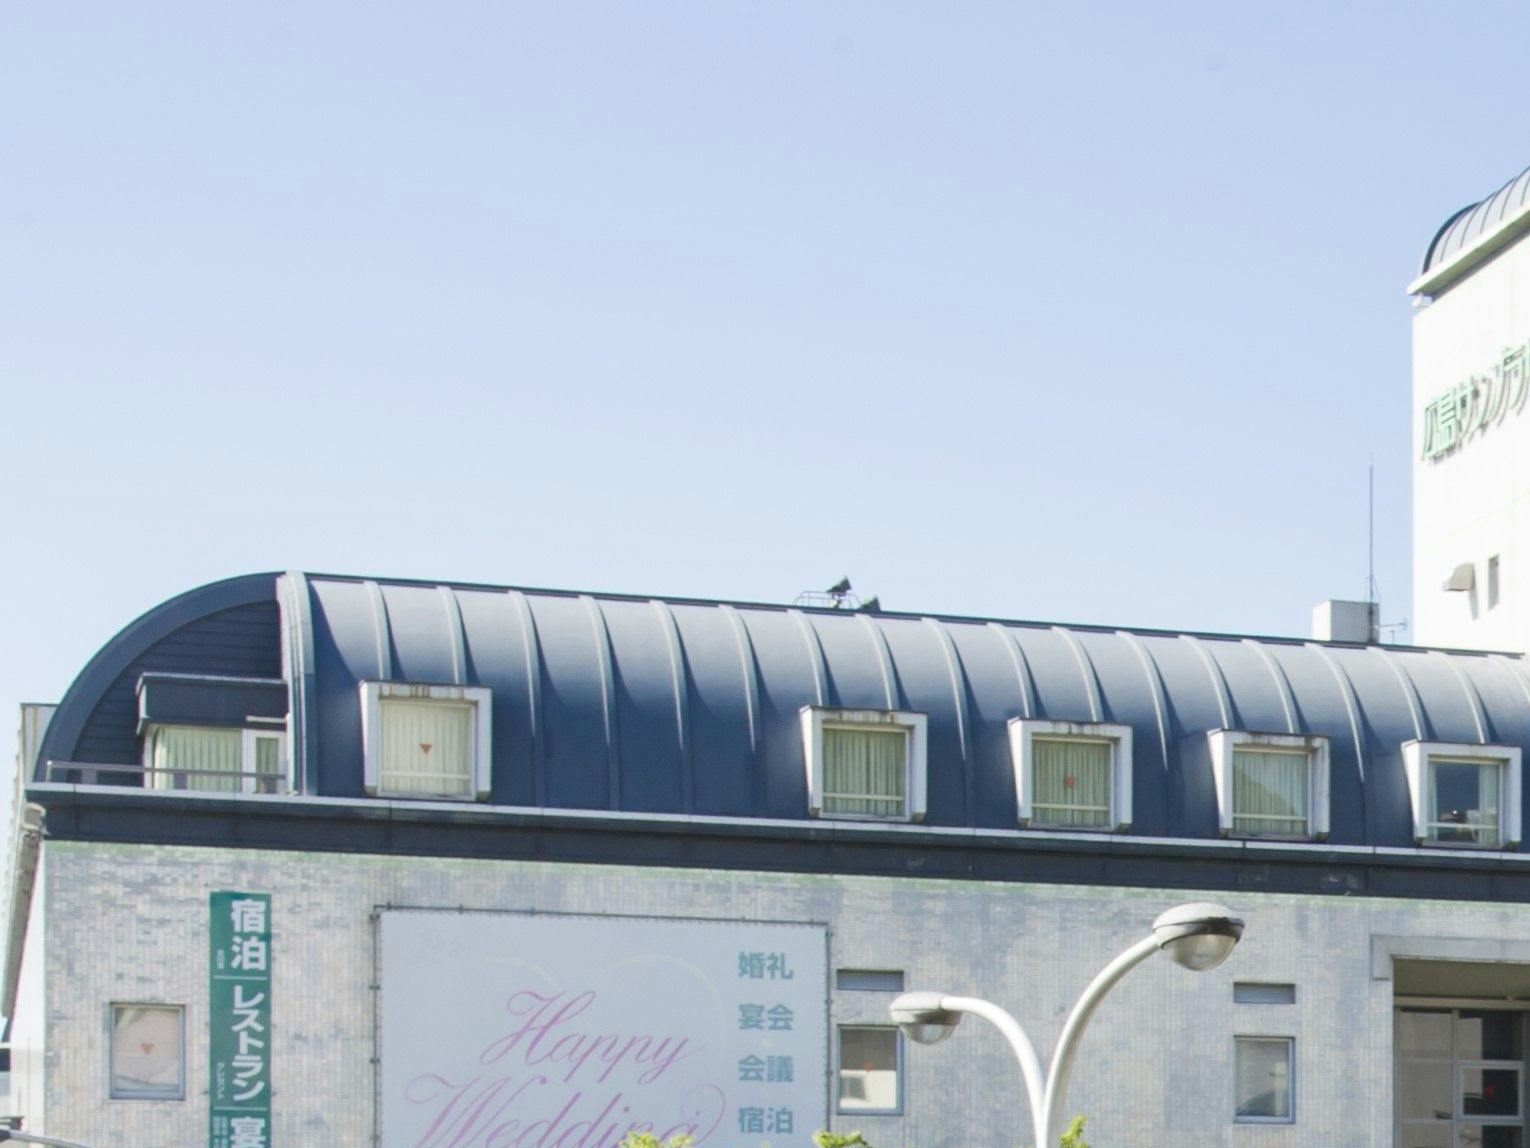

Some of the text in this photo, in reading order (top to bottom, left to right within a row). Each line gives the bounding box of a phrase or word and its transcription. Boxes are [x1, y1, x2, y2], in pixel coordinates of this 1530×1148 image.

[230, 899, 267, 970] 宿泊
[738, 952, 794, 980] 婚礼
[738, 1003, 794, 1031] 宴会
[231, 985, 265, 1101] レストラン
[479, 990, 707, 1085] Happy
[738, 1054, 794, 1083] 会議
[738, 1107, 794, 1135] 宿泊
